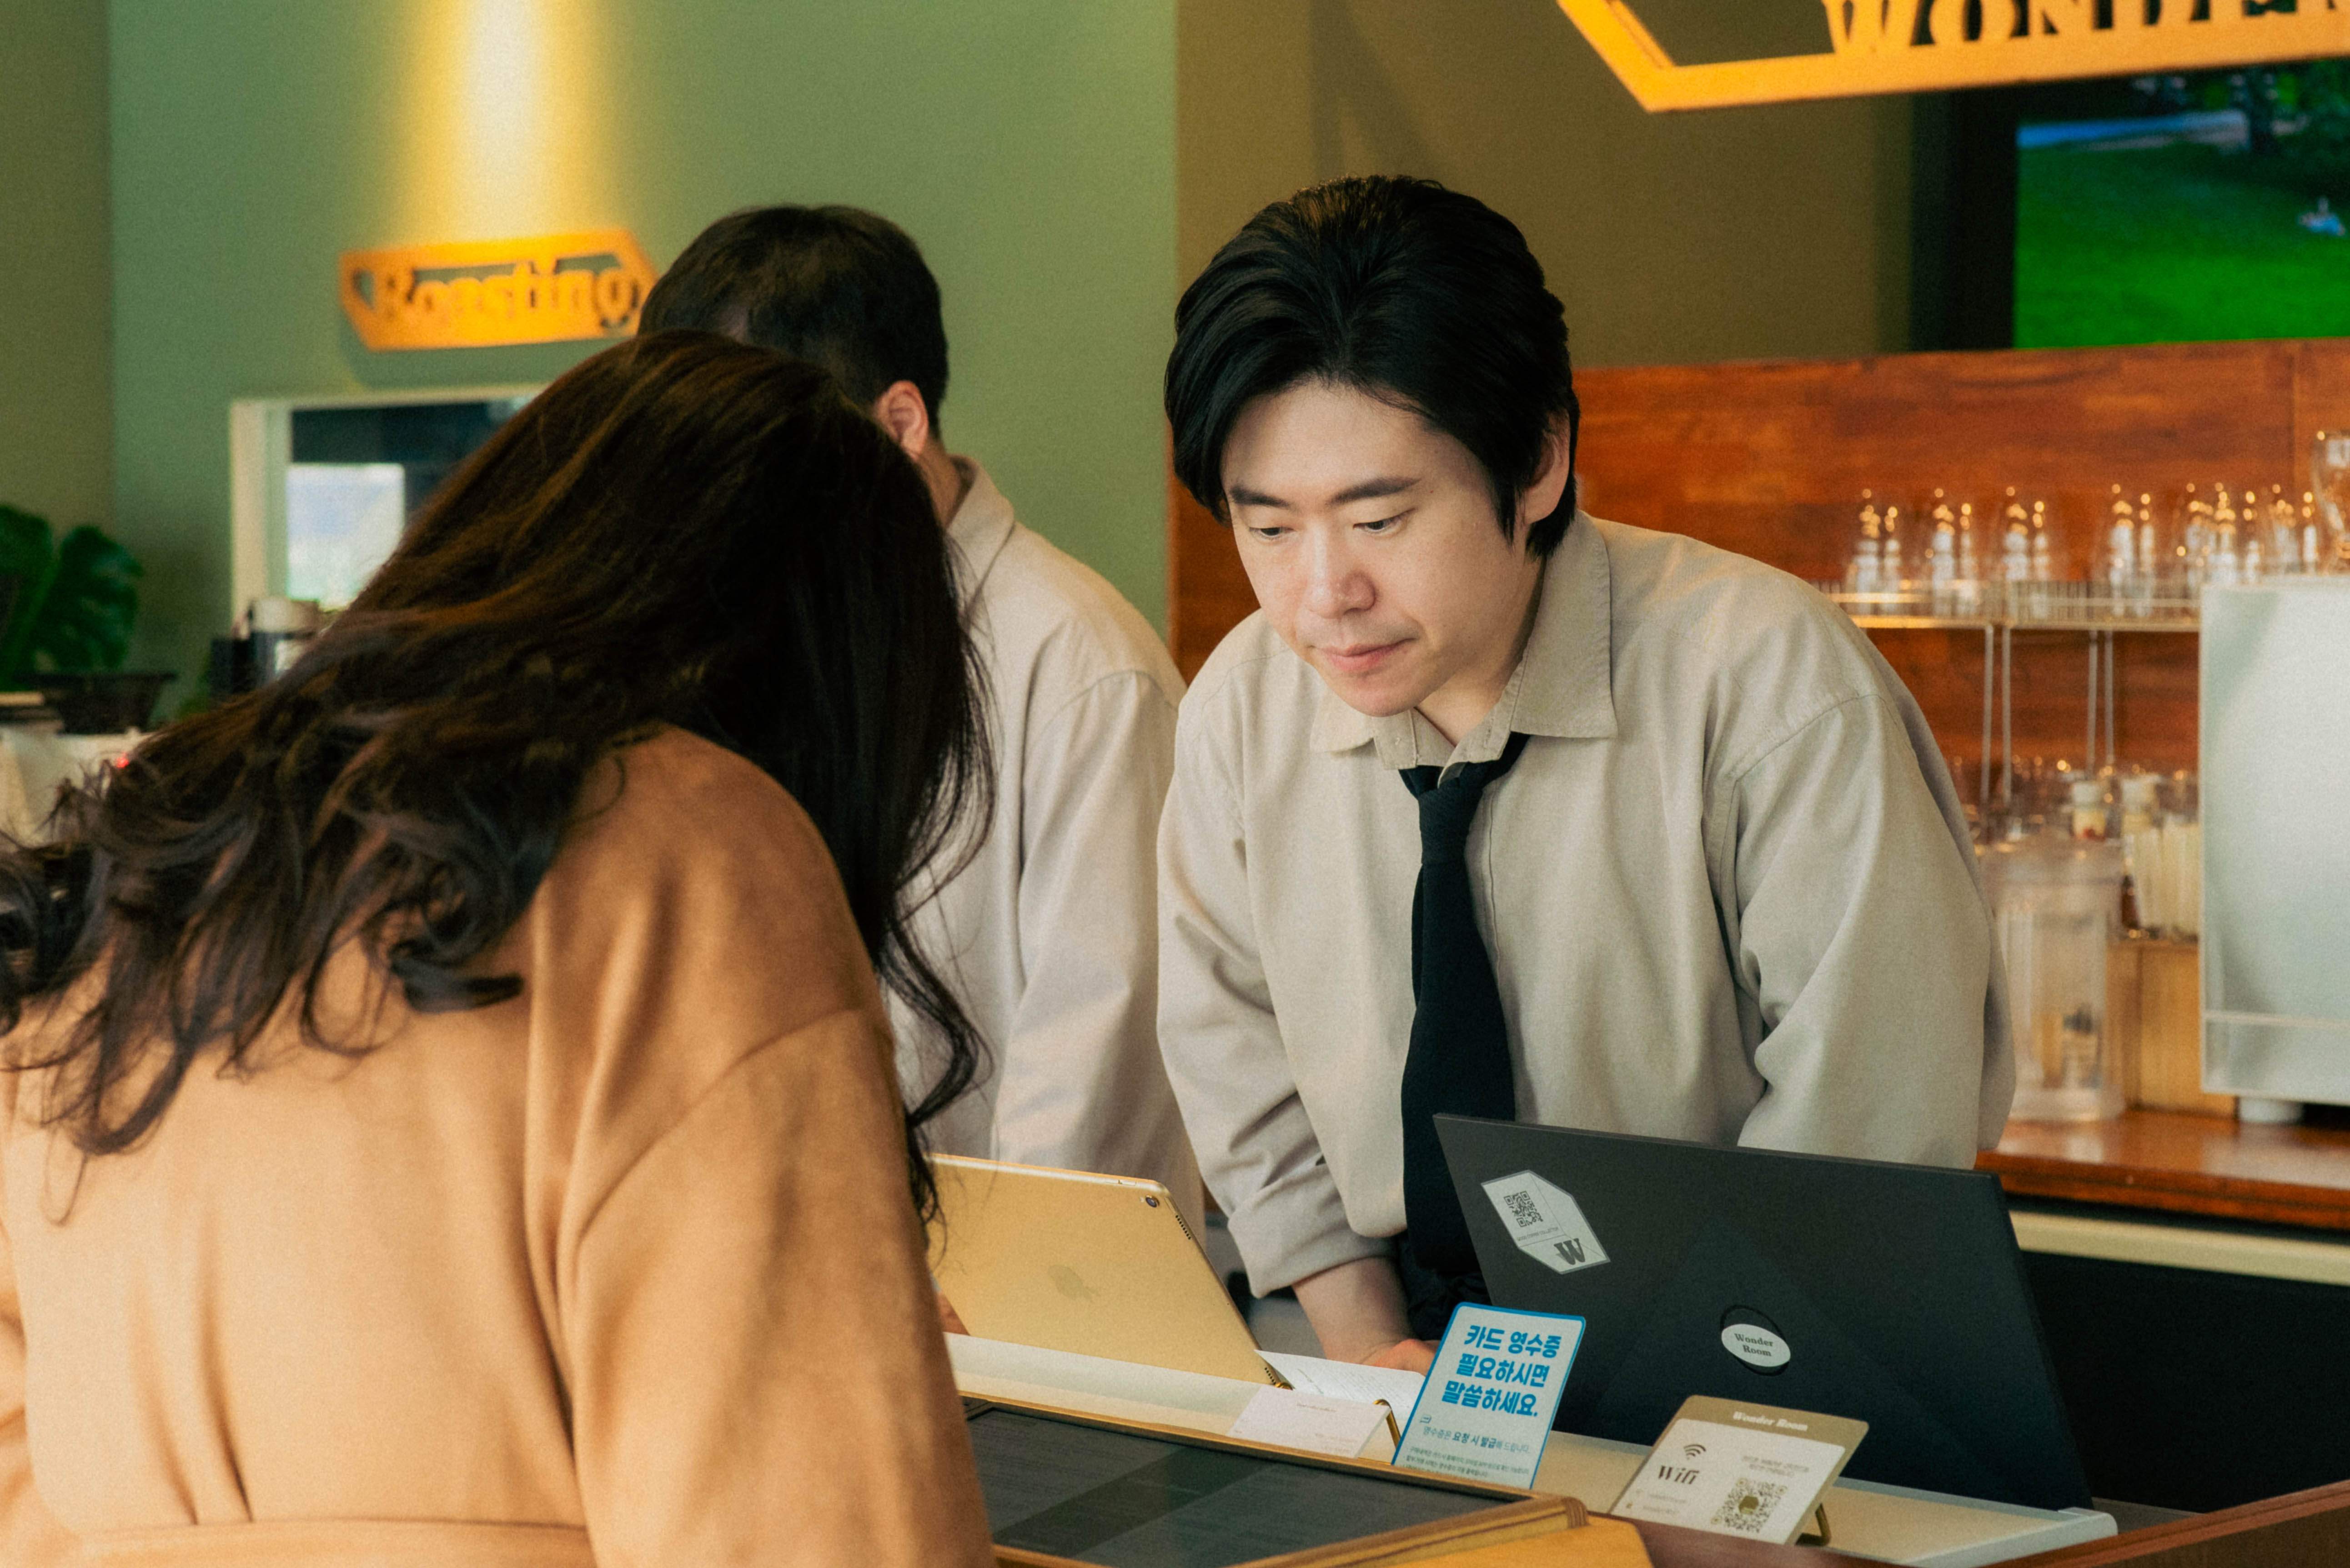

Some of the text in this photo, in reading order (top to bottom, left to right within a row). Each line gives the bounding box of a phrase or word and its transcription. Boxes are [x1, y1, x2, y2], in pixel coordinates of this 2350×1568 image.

[1820, 0, 2350, 55] WON
[1554, 1238, 1586, 1265] W
[1464, 1325, 1562, 1358] 카드 영수증
[1734, 1333, 1774, 1347] Wonder
[1742, 1345, 1772, 1357] Room
[1456, 1353, 1550, 1387] 필요하시면
[1441, 1380, 1538, 1417] 말씀하세요.
[1733, 1411, 1808, 1432] Wonder Room
[1423, 1426, 1451, 1440] 영수증은
[1452, 1432, 1470, 1443] 요청
[1471, 1436, 1480, 1446] 시
[1658, 1465, 1700, 1485] Wifi
